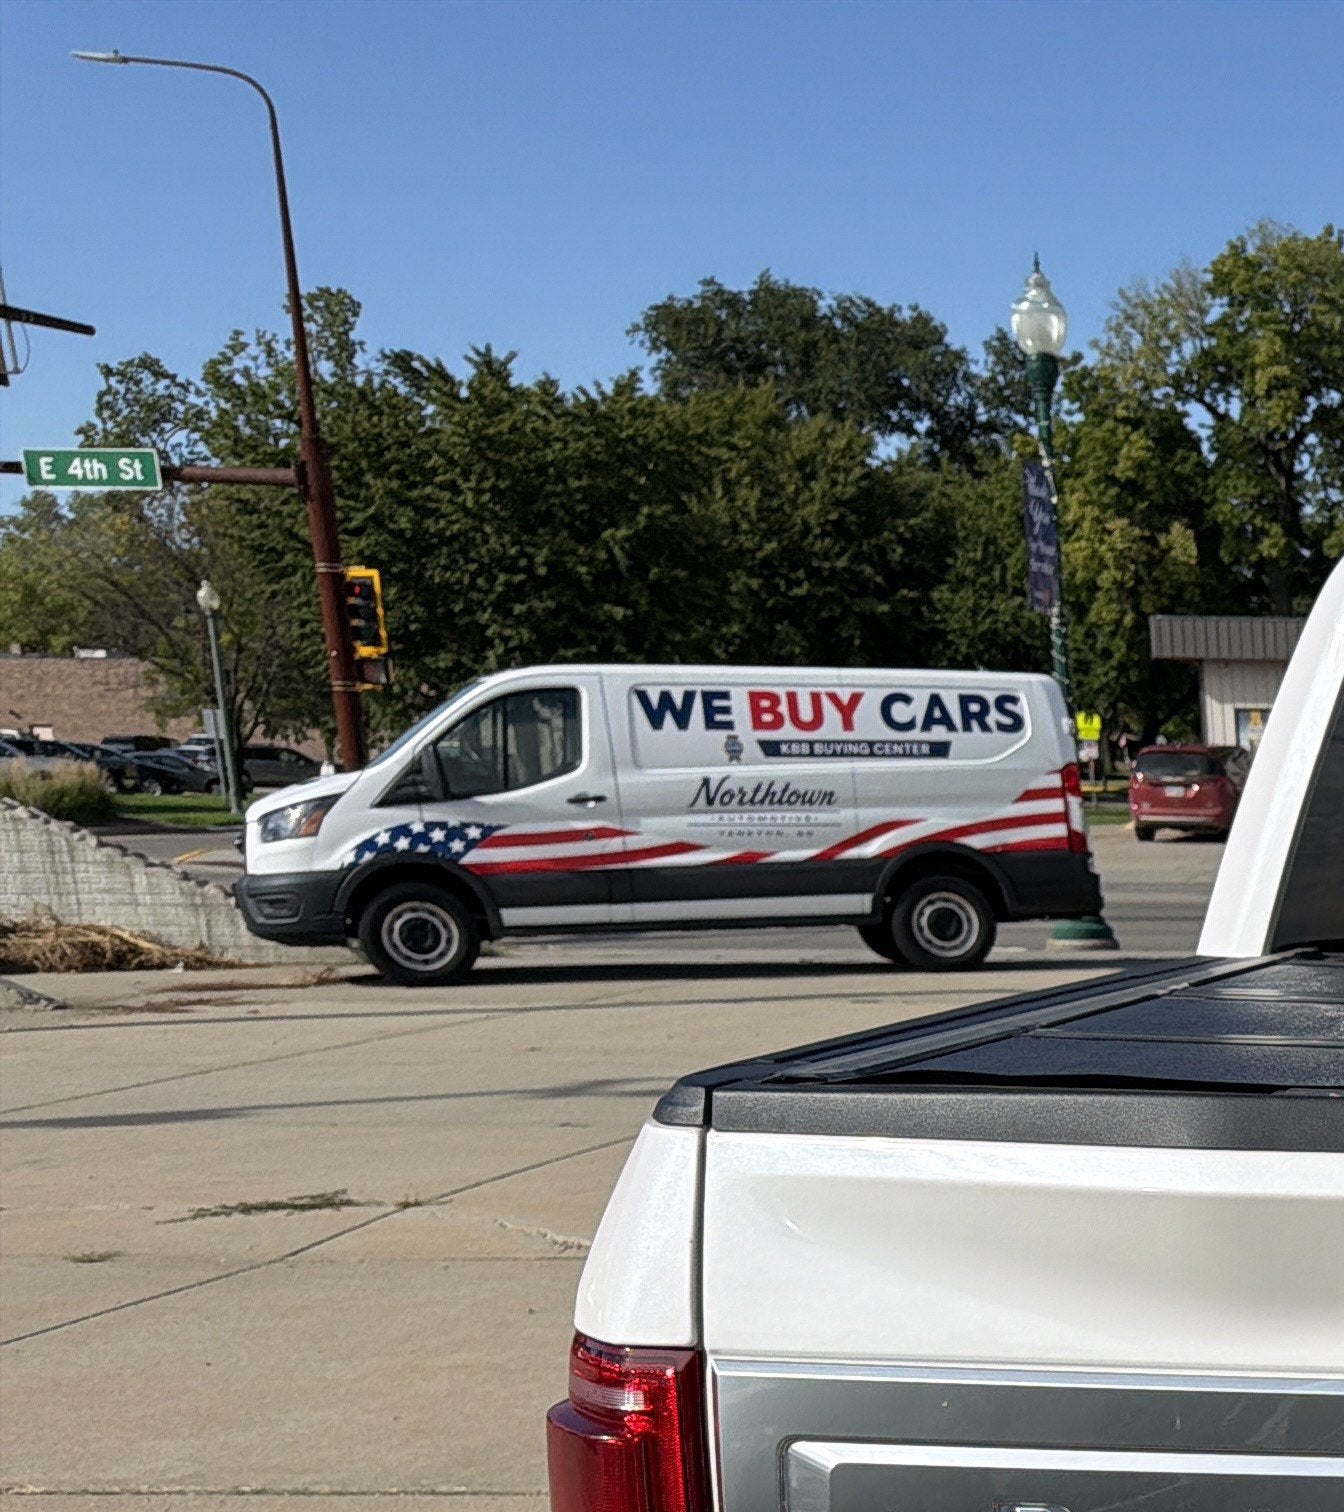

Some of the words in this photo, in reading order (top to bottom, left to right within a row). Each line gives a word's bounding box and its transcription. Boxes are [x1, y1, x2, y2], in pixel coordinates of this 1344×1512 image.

[38, 456, 56, 480] E
[67, 456, 108, 481] 4th
[118, 457, 145, 482] St
[633, 689, 735, 731] WE
[747, 690, 865, 733] BUY
[879, 693, 1026, 735] CARS
[779, 742, 810, 755] KBB
[813, 742, 871, 755] BUYING
[873, 743, 931, 756] CENTER
[688, 774, 838, 809] Northtown
